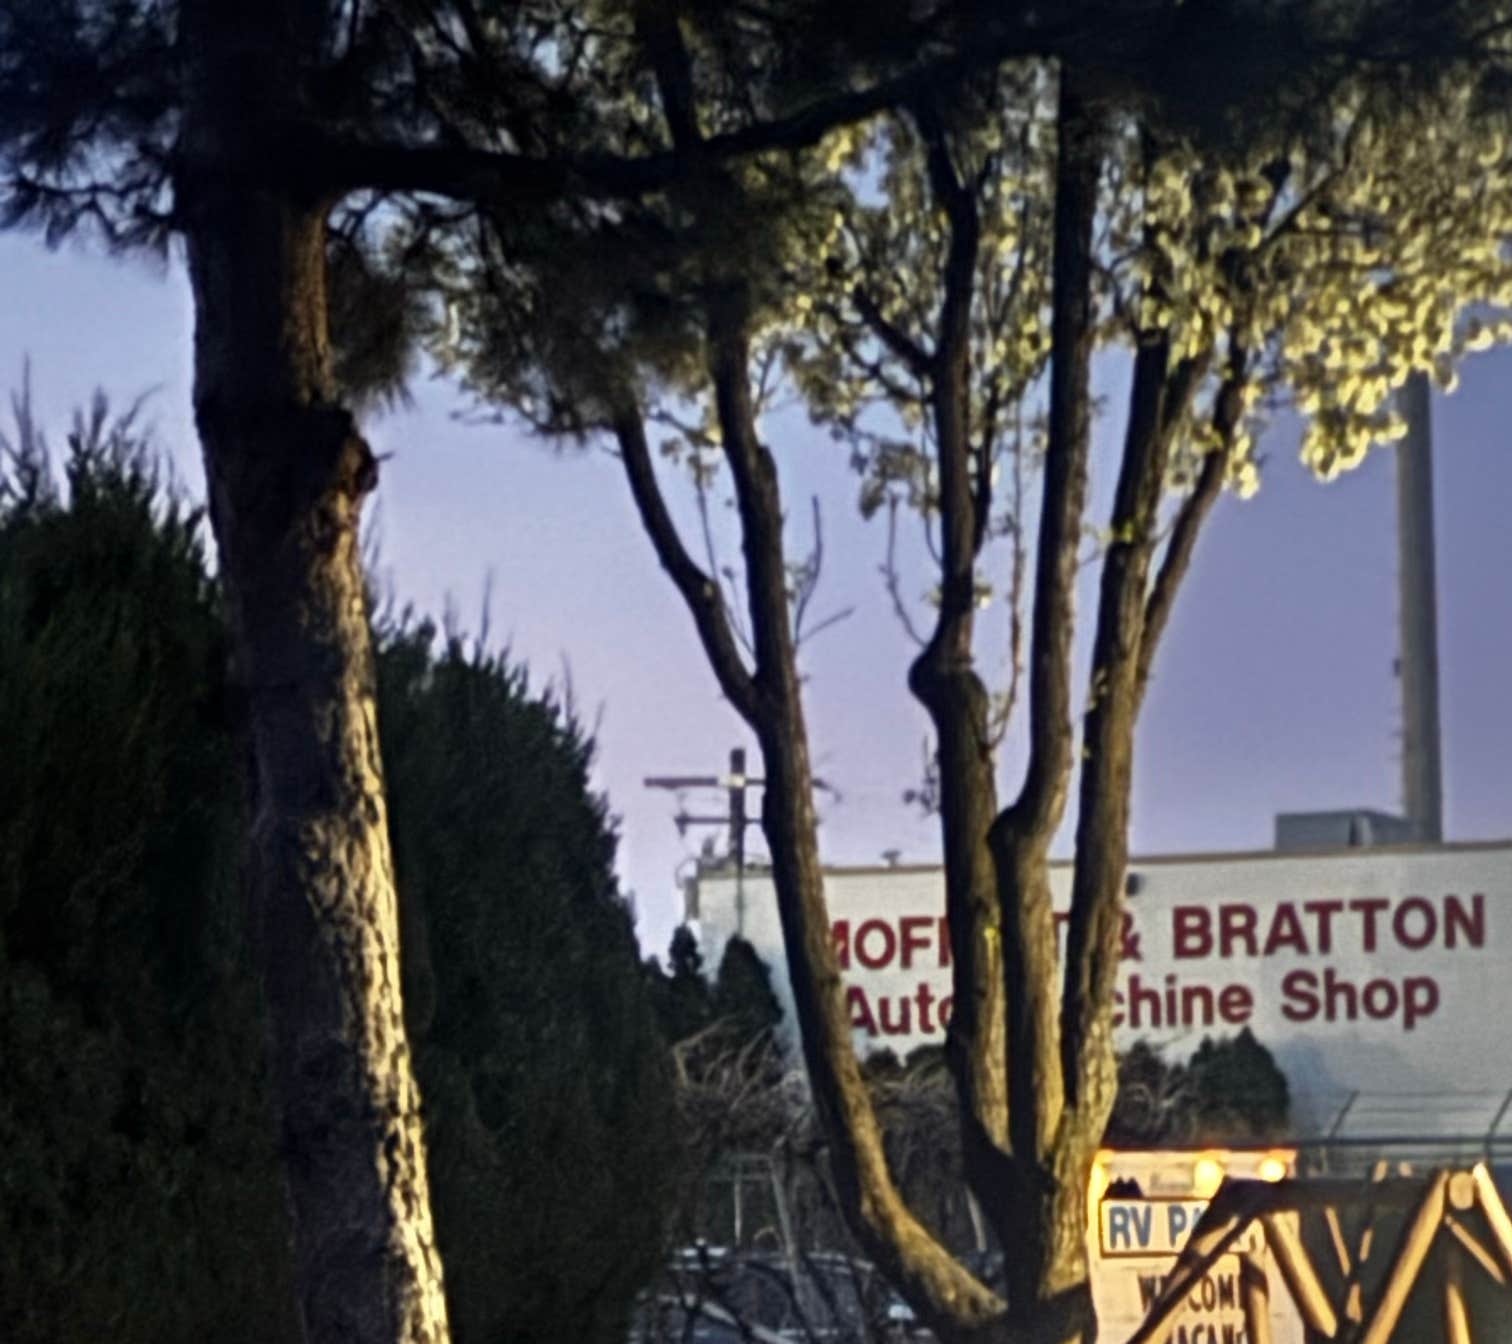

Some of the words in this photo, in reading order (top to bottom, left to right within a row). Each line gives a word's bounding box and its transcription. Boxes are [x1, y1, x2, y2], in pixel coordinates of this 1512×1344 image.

[1172, 893, 1486, 960] BRATTON
[1280, 966, 1440, 1032] Shop
[1109, 1205, 1152, 1249] RV
